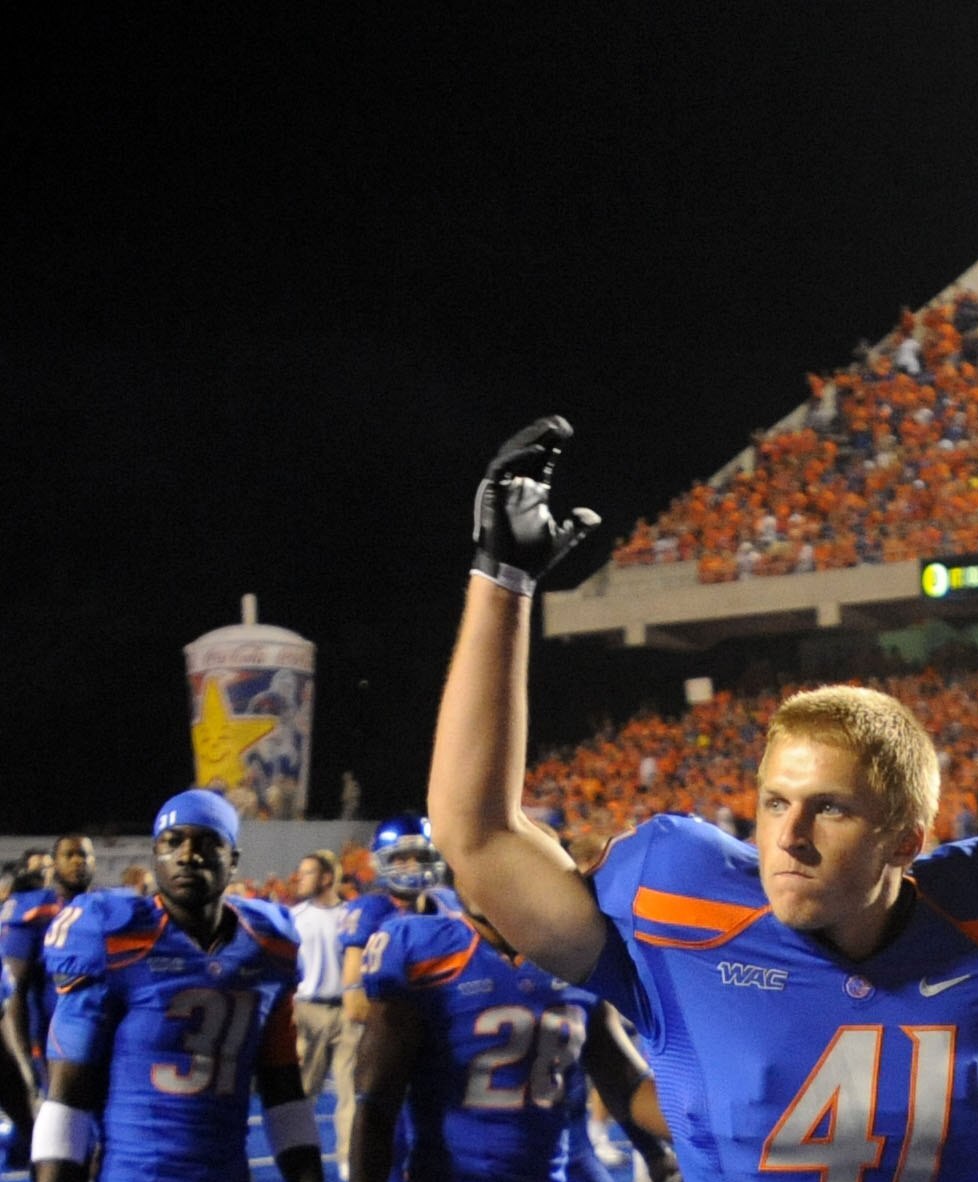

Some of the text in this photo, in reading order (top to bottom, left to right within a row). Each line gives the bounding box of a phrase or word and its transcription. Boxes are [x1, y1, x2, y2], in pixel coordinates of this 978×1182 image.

[717, 961, 789, 991] WAC
[150, 988, 260, 1095] 31
[461, 1004, 588, 1111] 28
